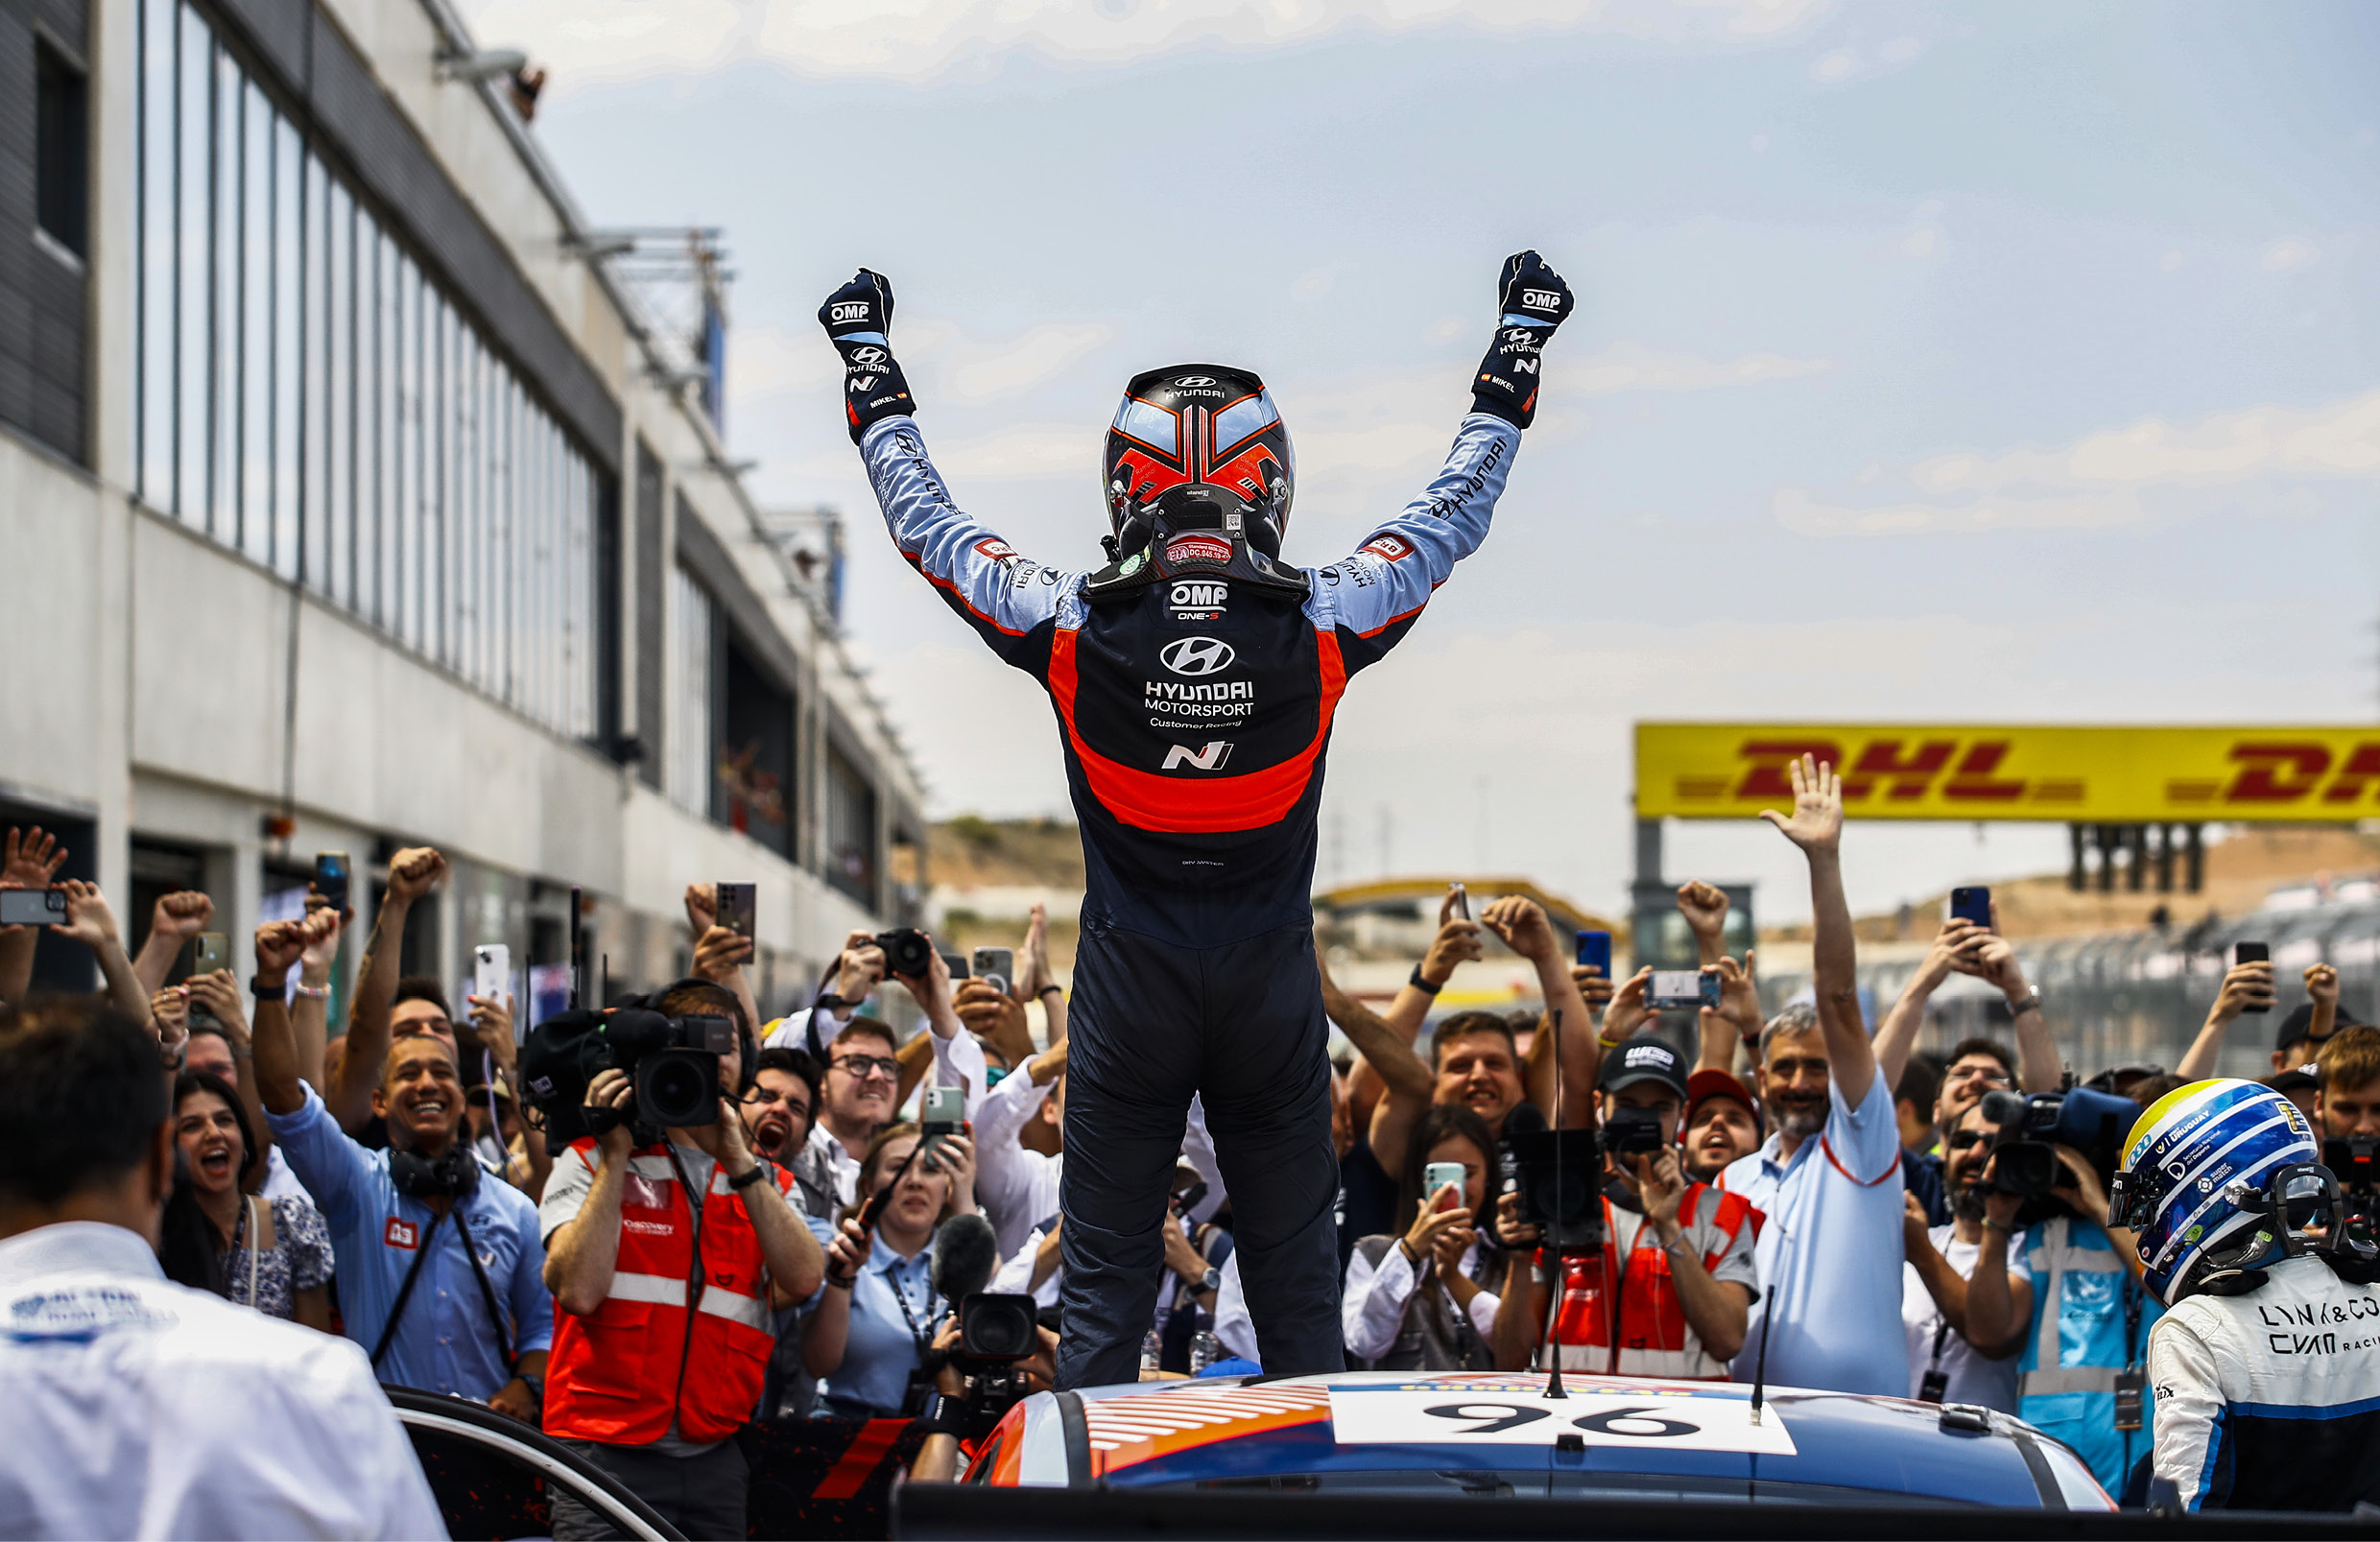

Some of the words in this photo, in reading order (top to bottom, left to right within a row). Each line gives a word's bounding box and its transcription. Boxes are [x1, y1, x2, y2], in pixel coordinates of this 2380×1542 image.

[1523, 292, 1560, 308] OMP
[831, 305, 869, 320] OMP
[847, 364, 890, 375] YUNDAI
[1491, 376, 1515, 392] MIKEL
[869, 395, 896, 409] MIKEL
[1165, 389, 1226, 400] HYUNDAI
[1450, 438, 1508, 510] HYUNDAI
[1170, 585, 1228, 605] OMP
[1178, 612, 1219, 621] ONE-S
[1145, 681, 1254, 701] HYUNDAI
[1145, 698, 1254, 717] MOTORSPORT
[1150, 718, 1203, 729] Customer
[1205, 720, 1243, 729] Racing
[1736, 740, 2026, 800] DHL
[2225, 743, 2380, 802] DH
[2170, 1110, 2210, 1143] URUGUAY
[2130, 1134, 2152, 1166] BSE
[2210, 1162, 2228, 1178] super
[2213, 1166, 2233, 1183] match
[2269, 1333, 2336, 1355] CYAN
[2344, 1337, 2380, 1352] RACI
[1423, 1403, 1701, 1436] 96
